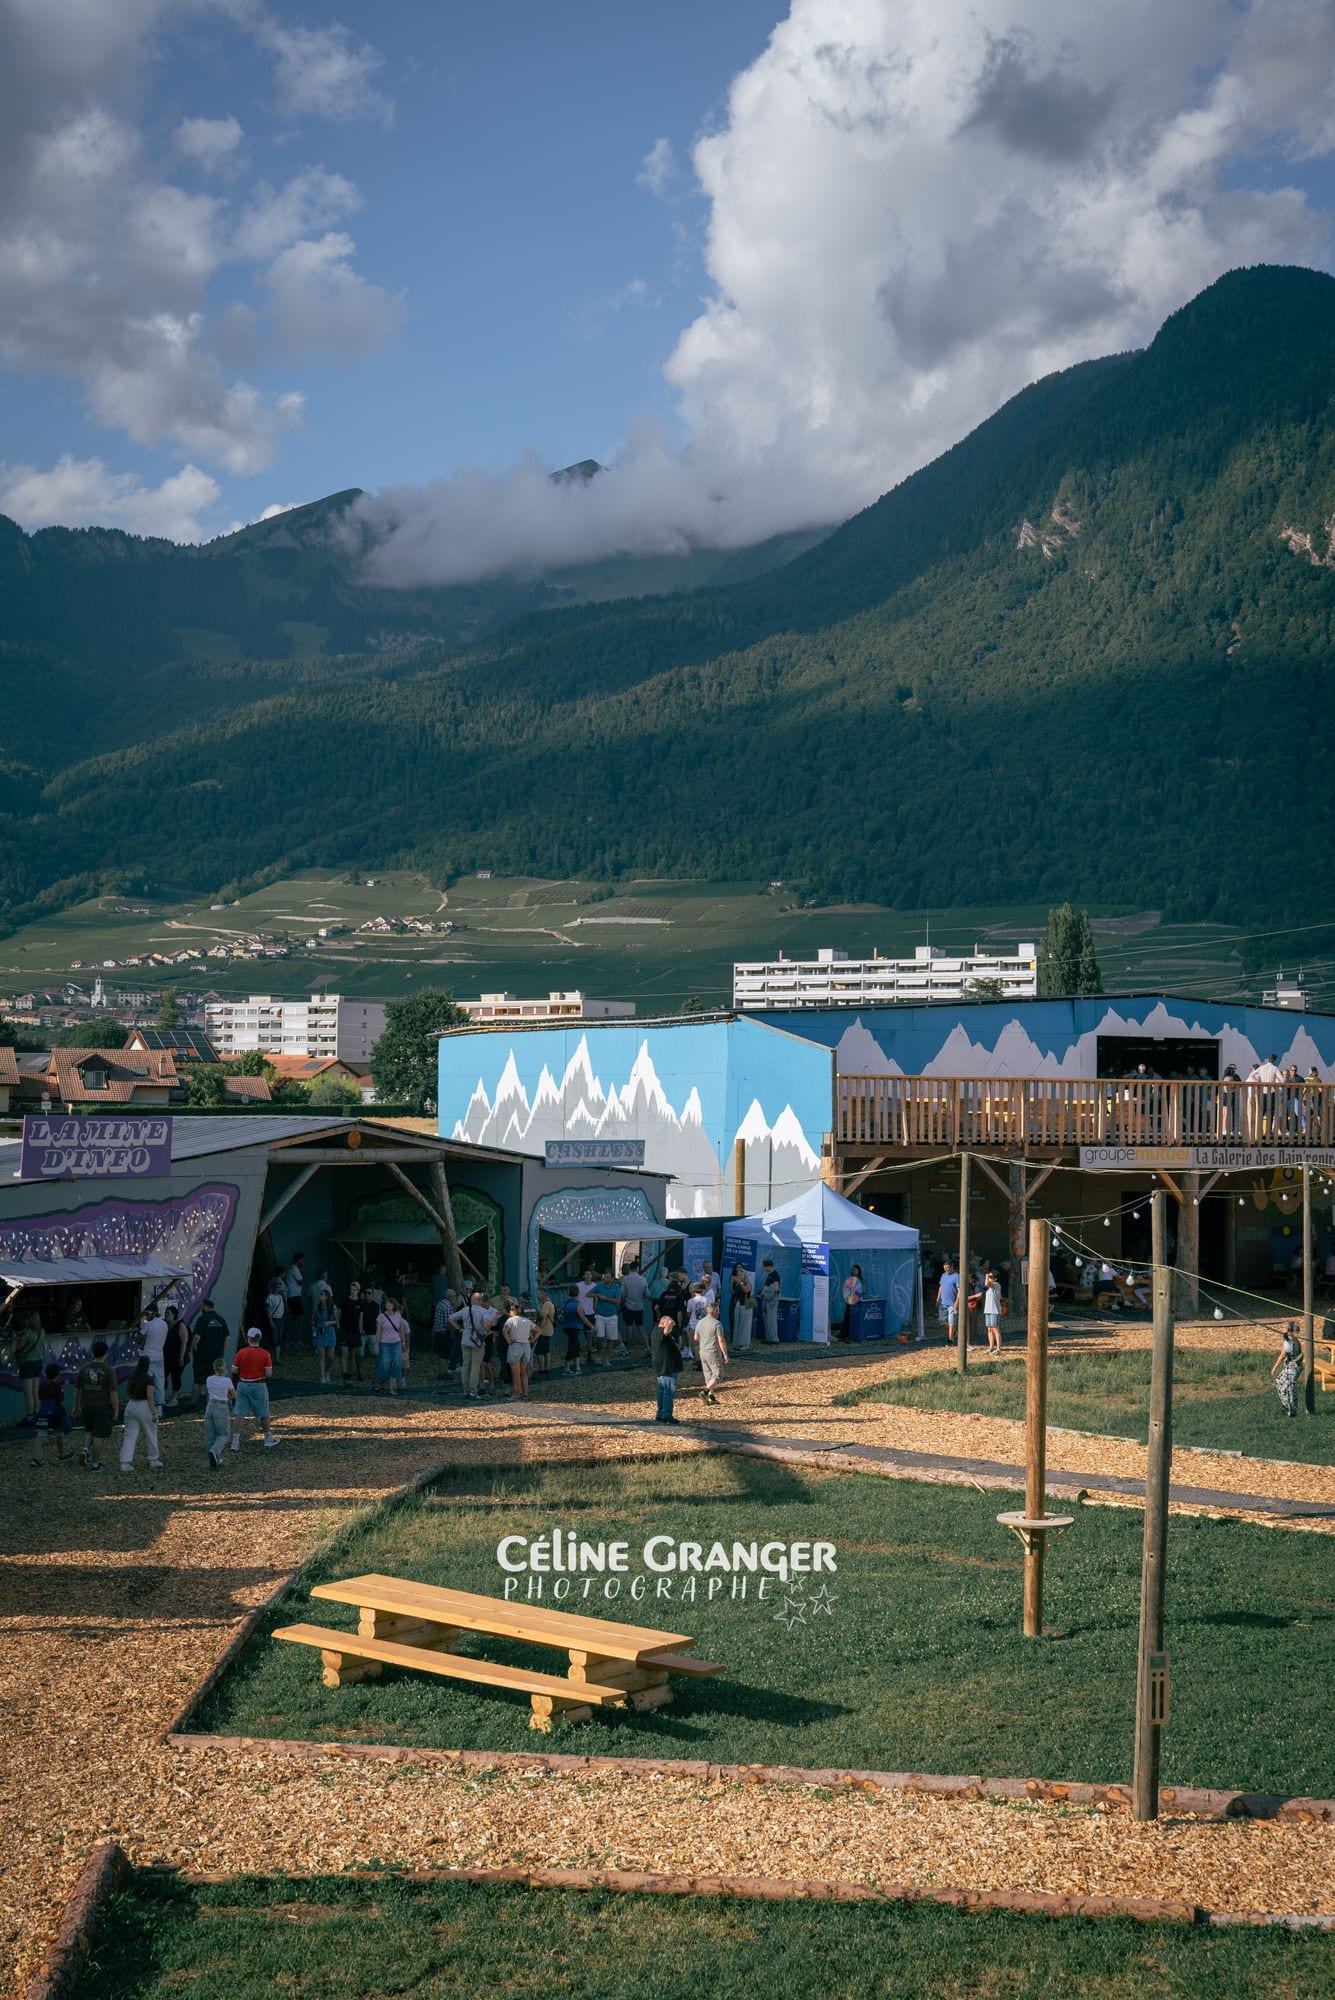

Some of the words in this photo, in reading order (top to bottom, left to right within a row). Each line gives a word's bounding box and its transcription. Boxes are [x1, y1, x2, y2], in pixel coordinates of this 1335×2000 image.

[40, 1147, 151, 1175] D'INFO
[546, 1142, 645, 1163] CASHLESS
[1196, 1148, 1208, 1165] La
[1212, 1148, 1252, 1165] Galerie
[1256, 1148, 1275, 1165] des
[687, 1248, 710, 1256] ANGEL
[863, 1311, 883, 1321] ANGEL
